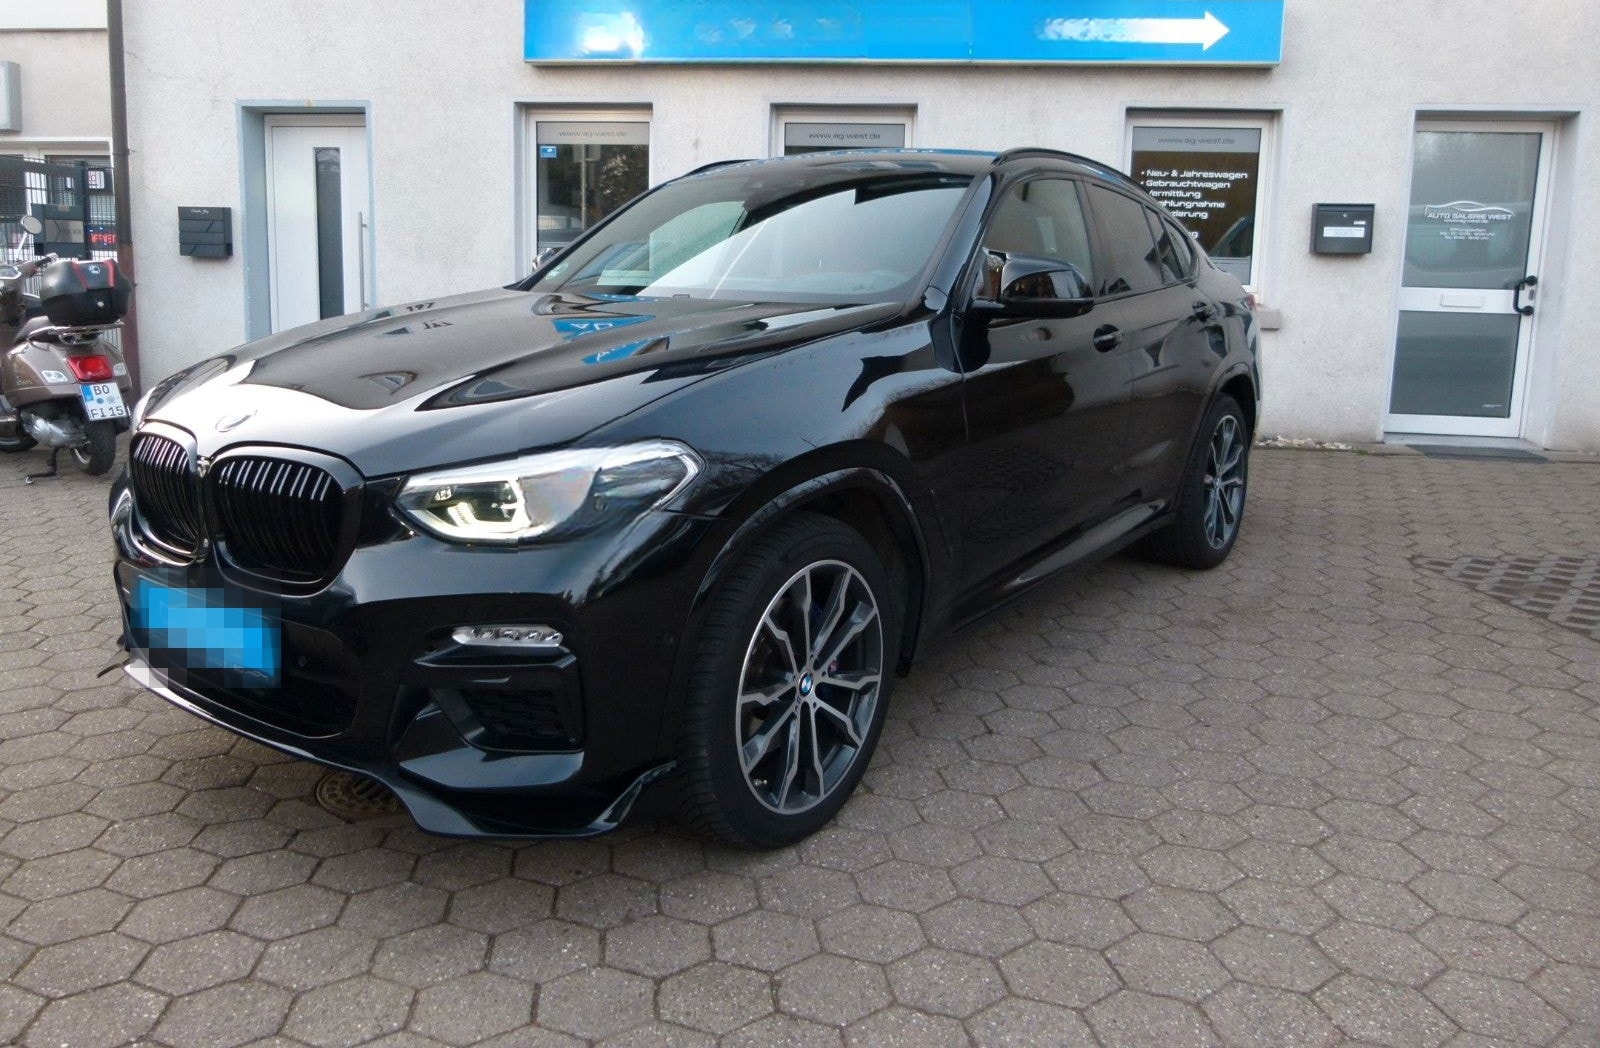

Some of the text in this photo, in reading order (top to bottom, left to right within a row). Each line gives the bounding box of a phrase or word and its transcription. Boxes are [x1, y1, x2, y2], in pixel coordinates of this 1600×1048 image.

[808, 131, 881, 140] www.ag-west.de
[1171, 169, 1178, 177] &
[1180, 170, 1248, 180] Jahreswagen
[1145, 180, 1231, 189] Gebrauchtwagen
[93, 384, 110, 396] BO
[91, 406, 124, 418] FI 15
